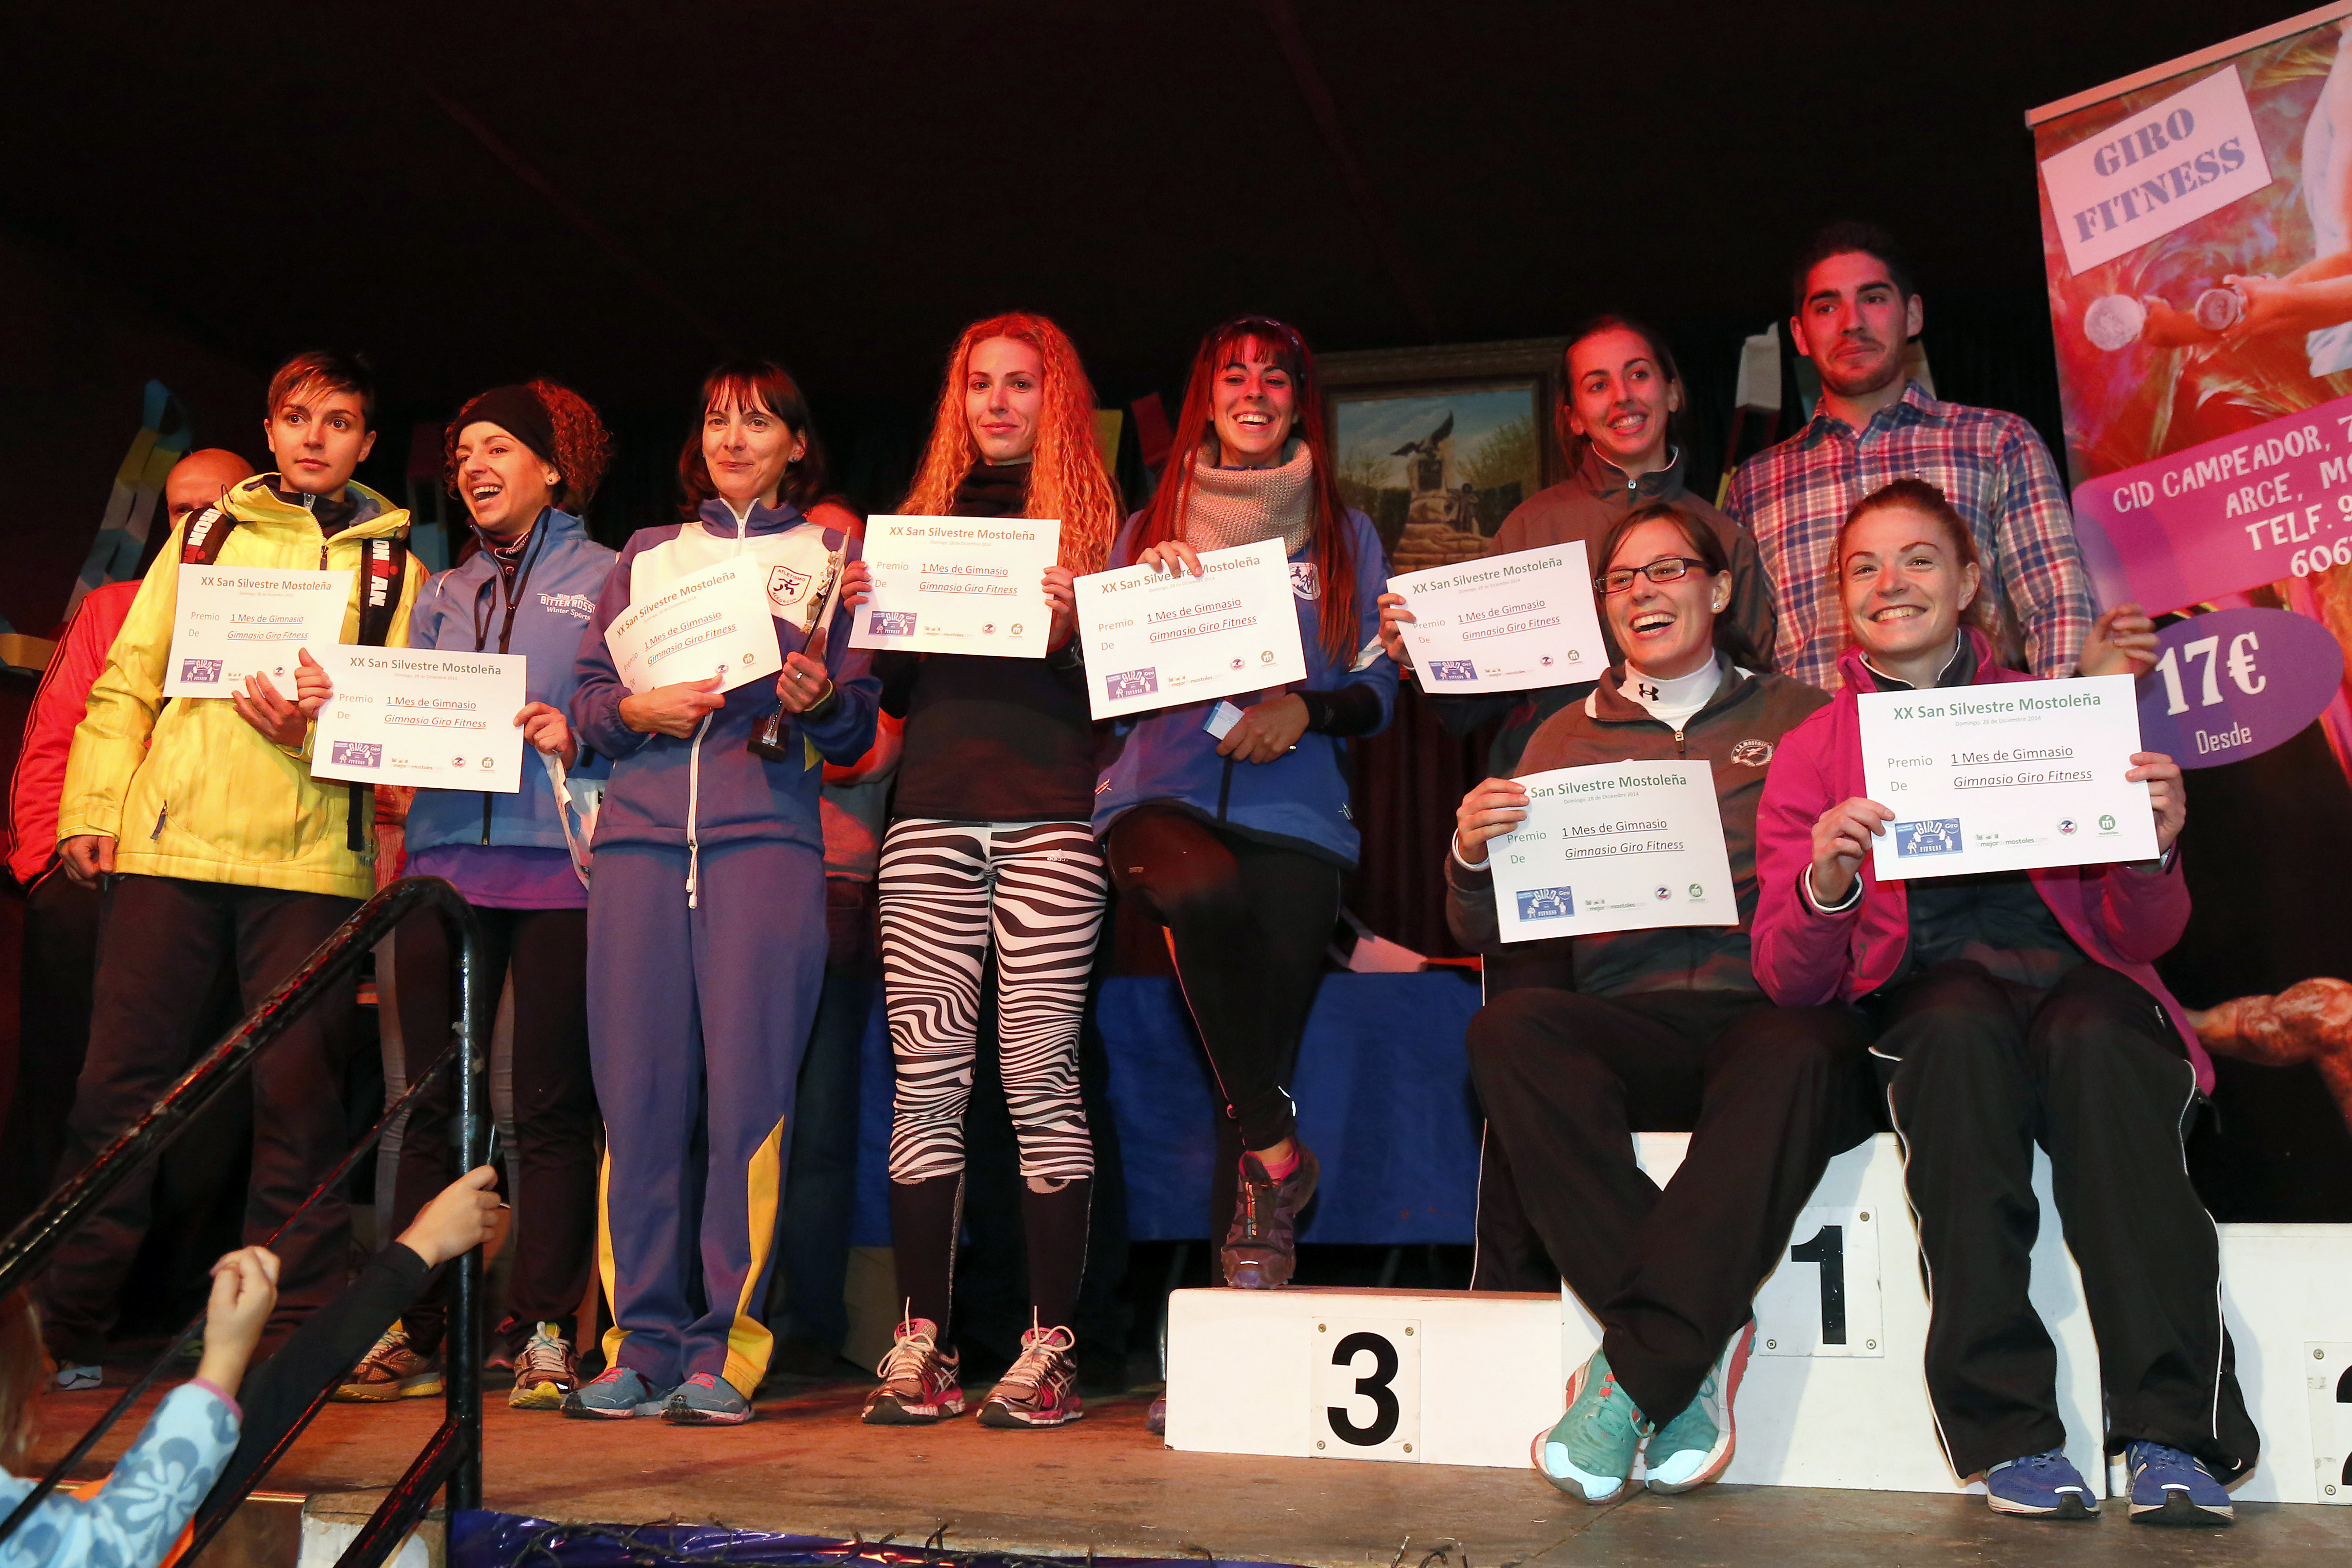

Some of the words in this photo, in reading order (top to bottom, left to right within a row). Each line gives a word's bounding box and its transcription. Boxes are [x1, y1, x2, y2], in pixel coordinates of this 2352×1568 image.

[2094, 108, 2194, 176] GIRO
[2074, 136, 2245, 243] FITNESS
[2113, 481, 2155, 513] CID
[2162, 425, 2330, 497] CAMPEADOR,
[2320, 453, 2352, 489] M
[890, 526, 903, 536] XX
[906, 527, 925, 537] San
[928, 528, 974, 539] Silvestre
[978, 530, 1035, 540] Mostoleña
[2246, 504, 2332, 551] TELF.
[877, 562, 909, 571] Premio
[930, 564, 948, 573] Mes
[966, 566, 1008, 576] Gimnasio
[2291, 536, 2352, 578] 606
[201, 577, 214, 586] XX
[217, 578, 234, 587] San
[238, 578, 278, 589] Silvestre
[282, 580, 331, 591] Mostoleña
[778, 569, 805, 582] ATLETISMO
[875, 579, 887, 588] De
[920, 582, 962, 592] Gimnasio
[965, 584, 984, 592] Giro
[986, 585, 1017, 594] Fitness
[1101, 583, 1117, 594] XX
[1120, 578, 1141, 590] San
[1413, 584, 1427, 594] XX
[1431, 579, 1450, 590] San
[1453, 570, 1500, 586] Silvestre
[1503, 558, 1562, 576] Mostoleña
[540, 596, 570, 607] BITTER
[617, 625, 625, 638] XX
[625, 615, 638, 630] San
[639, 593, 677, 617] Silvestre
[680, 571, 735, 596] Mostoleña
[773, 592, 797, 603] ALCORCON
[191, 612, 219, 620] Premio
[570, 609, 591, 620] Sports
[1099, 619, 1133, 632] Premio
[1156, 611, 1177, 621] Mes
[1180, 607, 1191, 616] de
[1195, 598, 1241, 614] Gimnasio
[1413, 619, 1445, 629] Premio
[1467, 612, 1486, 622] Mes
[1489, 608, 1500, 617] de
[1502, 599, 1545, 615] Gimnasio
[228, 631, 263, 640] Gimnasio
[1101, 641, 1114, 651] De
[1150, 627, 1196, 641] Gimnasio
[1199, 622, 1219, 632] Giro
[1223, 615, 1256, 628] Fitness
[1463, 626, 1504, 640] Gimnasio
[1508, 622, 1526, 633] Giro
[1529, 616, 1560, 630] Fitness
[624, 652, 638, 673] Premio
[650, 633, 666, 646] Mes
[668, 627, 677, 638] de
[680, 611, 721, 630] Gimnasio
[350, 657, 365, 667] XX
[369, 659, 387, 669] San
[392, 660, 439, 671] Silvestre
[443, 663, 501, 674] Mostoleña
[630, 679, 635, 688] De
[648, 642, 682, 665] Gimnasio
[685, 635, 703, 646] Giro
[706, 624, 736, 639] Fitness
[2155, 632, 2266, 716] 17€
[339, 693, 373, 703] Premio
[396, 697, 415, 706] Mes
[432, 699, 476, 709] Gimnasio
[1894, 707, 1913, 720] XX
[1918, 705, 1944, 717] San
[1950, 699, 2014, 716] Silvestre
[2020, 693, 2101, 711] Mostoleña
[385, 714, 428, 725] Gimnasio
[432, 717, 451, 726] Giro
[454, 718, 486, 728] Fitness
[2196, 722, 2252, 755] Desde
[1888, 755, 1933, 769] Premio
[1951, 753, 1957, 764] 1
[1963, 751, 1989, 763] Mes
[1994, 749, 2009, 761] de
[2013, 745, 2073, 760] Gimnasio
[1531, 786, 1554, 798] San
[1559, 778, 1615, 795] Silvestre
[1620, 774, 1686, 788] Mostoleña
[1891, 781, 1907, 792] De
[1954, 774, 2013, 788] Gimnasio
[2017, 772, 2044, 783] Giro
[2048, 769, 2092, 781] Fitness
[1507, 831, 1547, 844] Premio
[1562, 827, 1567, 837] 1
[1572, 825, 1595, 836] Mes
[1599, 823, 1613, 832] de
[1616, 819, 1667, 831] Gimnasio
[1915, 821, 1942, 835] GIRO
[1511, 854, 1525, 863] De
[1566, 845, 1617, 859] Gimnasio
[1621, 842, 1643, 852] Giro
[1647, 840, 1683, 851] Fitness
[1533, 889, 1556, 901] GIRO
[1791, 1225, 1846, 1345] 1
[1328, 1332, 1399, 1446] 3
